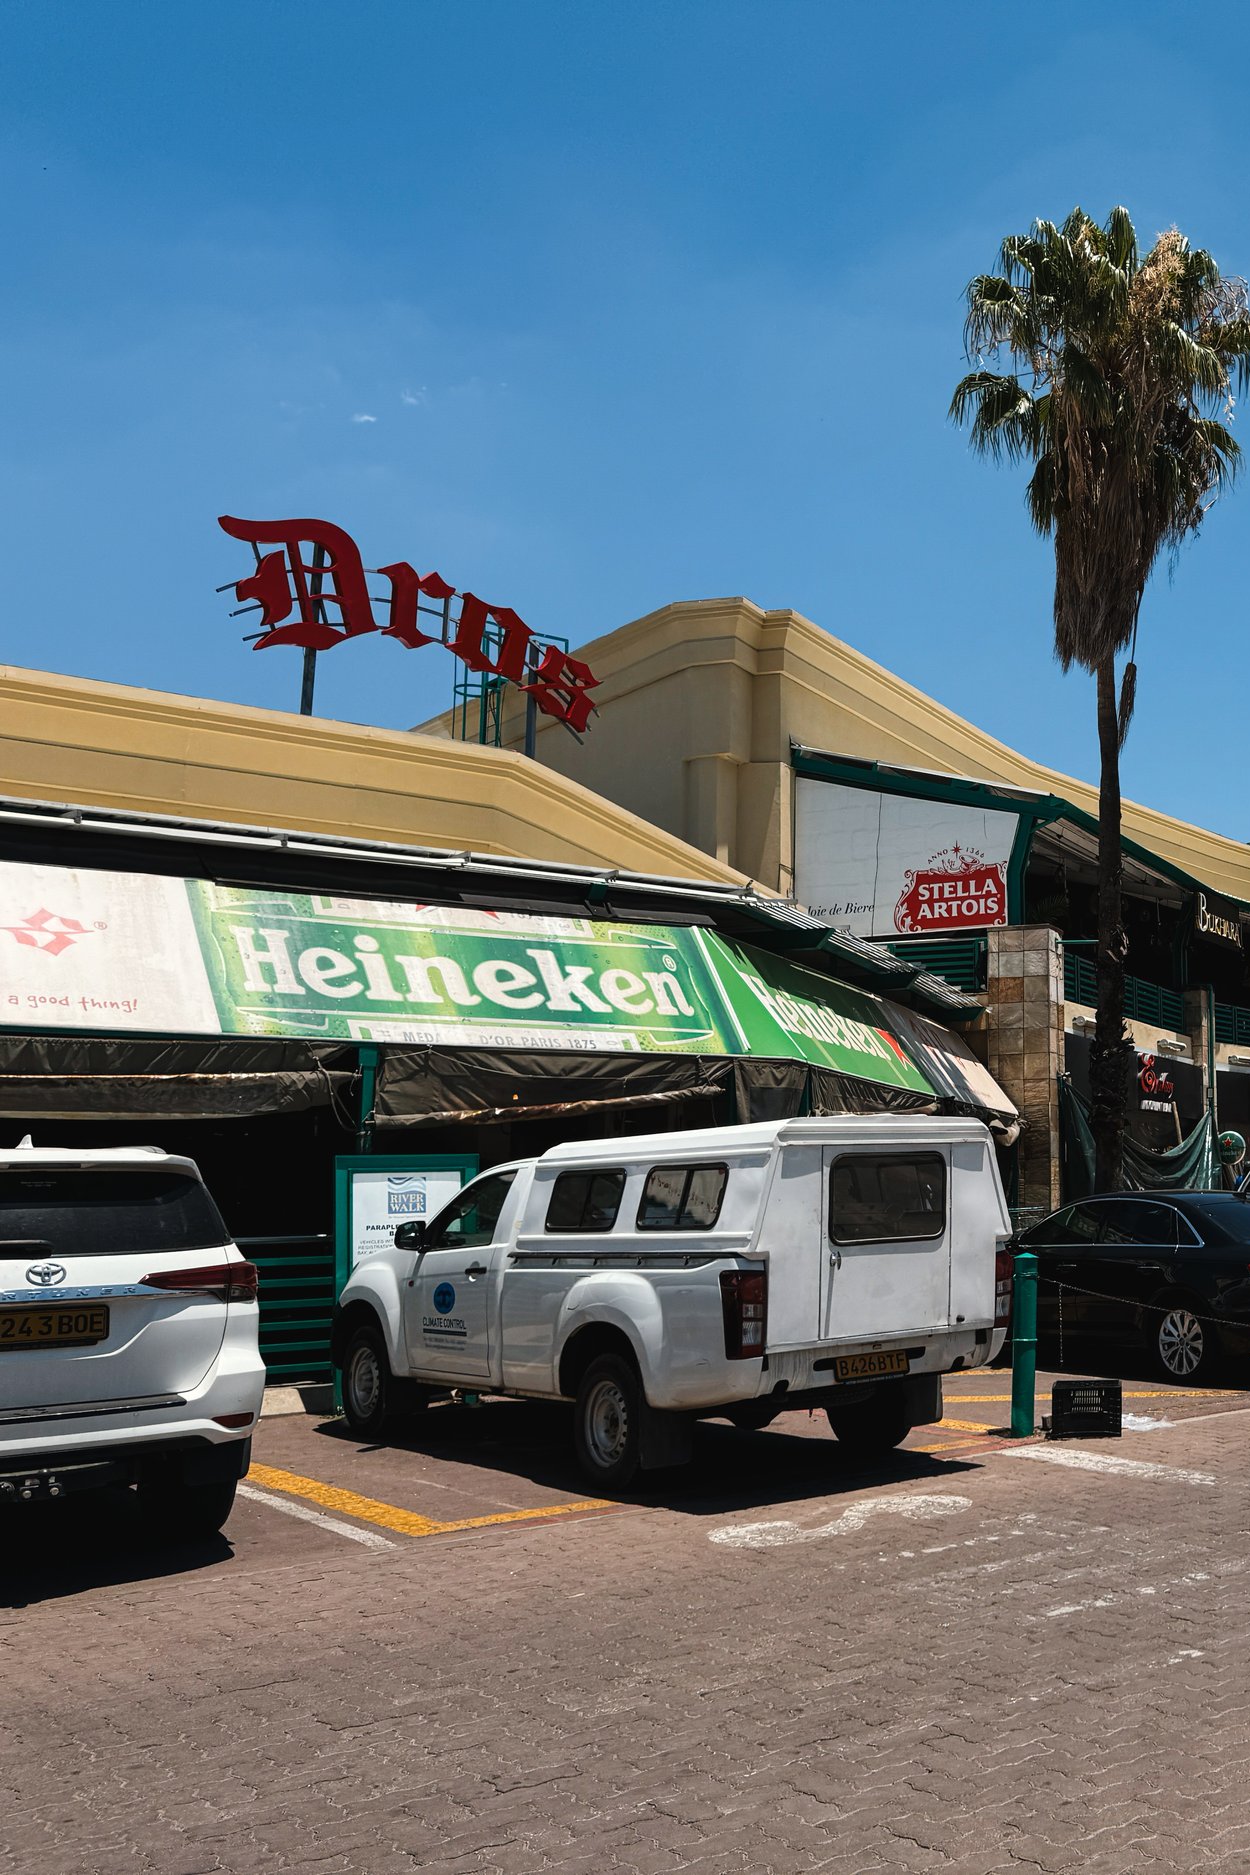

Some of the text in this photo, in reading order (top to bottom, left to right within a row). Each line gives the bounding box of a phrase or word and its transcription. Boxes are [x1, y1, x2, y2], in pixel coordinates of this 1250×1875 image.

[217, 515, 603, 733] Dros
[927, 846, 986, 865] ANNO 1366
[917, 878, 998, 901] STELLA
[829, 904, 843, 916] de
[844, 902, 875, 915] Biere
[916, 897, 1000, 920] ARTOIS
[1198, 891, 1242, 948] BUKHARA
[230, 925, 695, 1017] Heineken
[8, 994, 138, 1013] a good thing!
[739, 971, 892, 1062] Heineken
[480, 1034, 513, 1046] D'OR
[522, 1036, 562, 1049] PARIS
[567, 1039, 598, 1050] 1875
[389, 1202, 425, 1213] WALK
[390, 1193, 424, 1203] RIVER
[366, 1223, 400, 1231] PARAPLE
[423, 1316, 467, 1330] CLIMATE CONTROL
